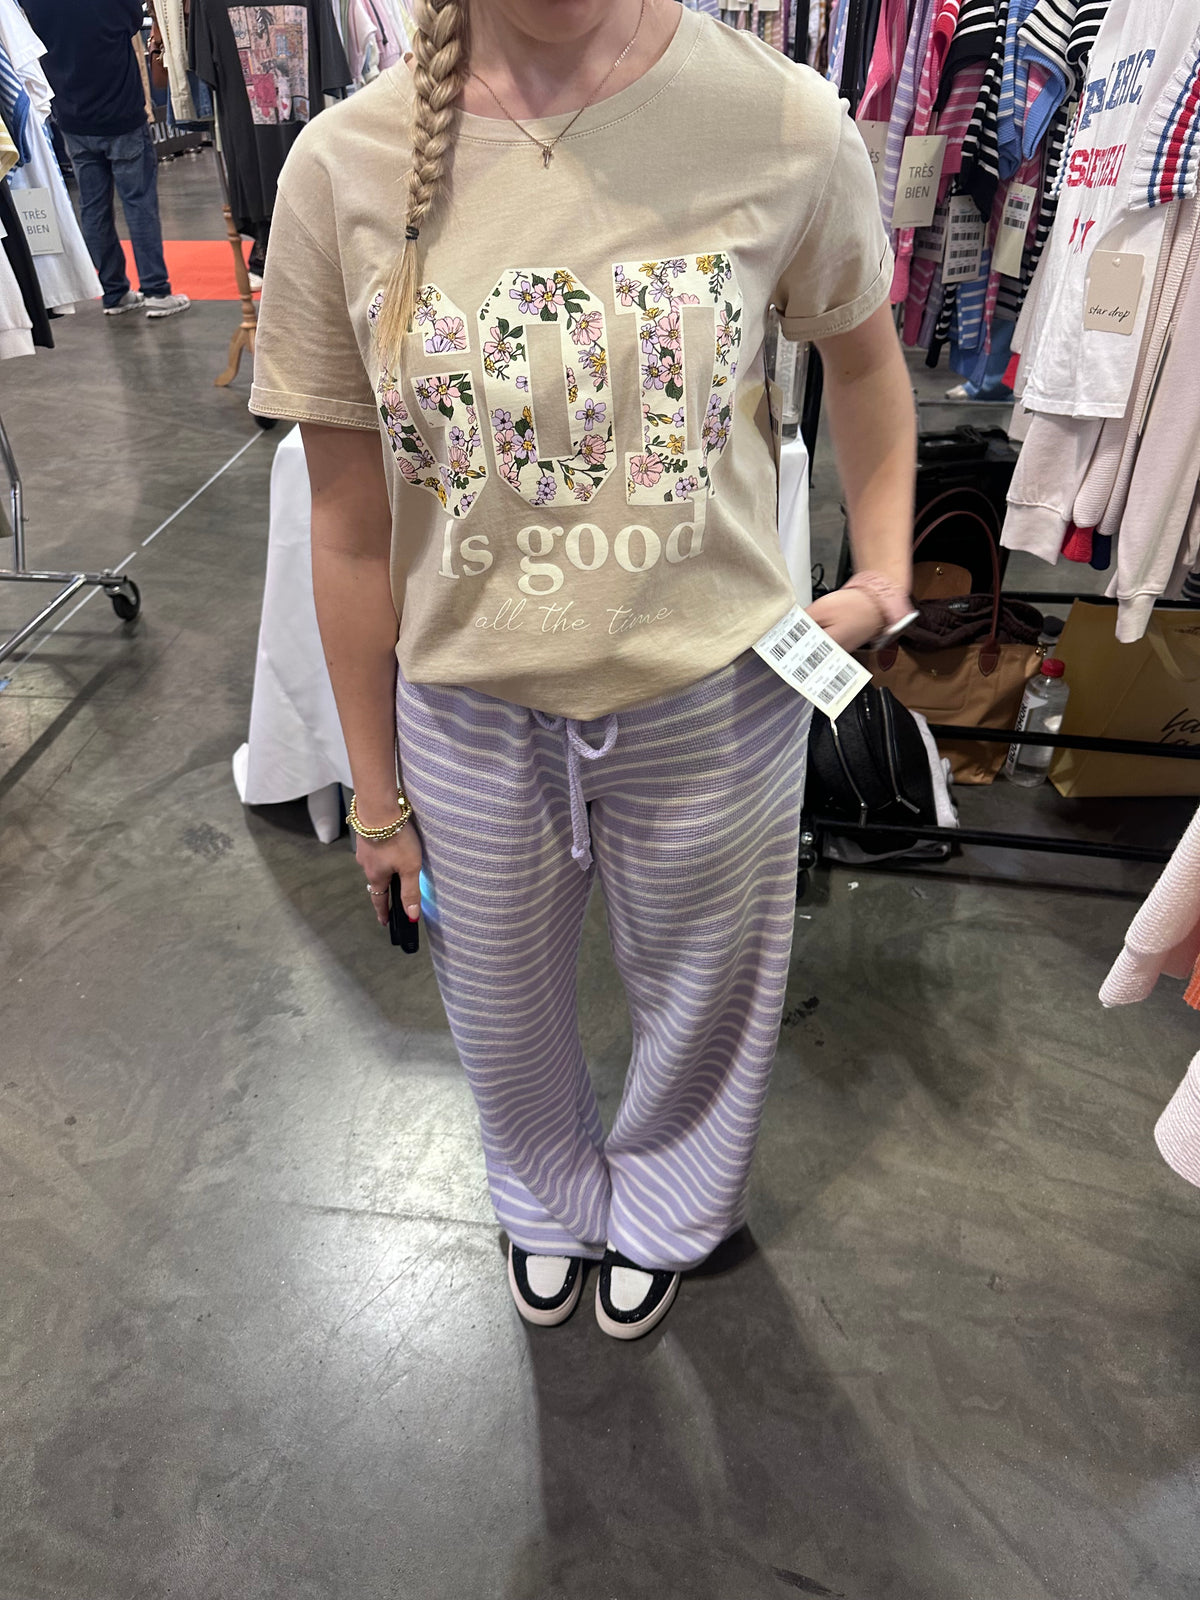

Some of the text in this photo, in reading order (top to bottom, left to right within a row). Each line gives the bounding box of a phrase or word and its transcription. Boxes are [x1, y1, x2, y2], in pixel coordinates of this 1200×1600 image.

[909, 163, 935, 179] TRÈS
[904, 186, 930, 199] BIEN
[22, 208, 47, 220] TRÈS
[26, 224, 50, 235] BIEN
[1088, 304, 1131, 323] star drop
[367, 251, 744, 519] GOD
[516, 487, 705, 596] good
[474, 598, 674, 635] all the time
